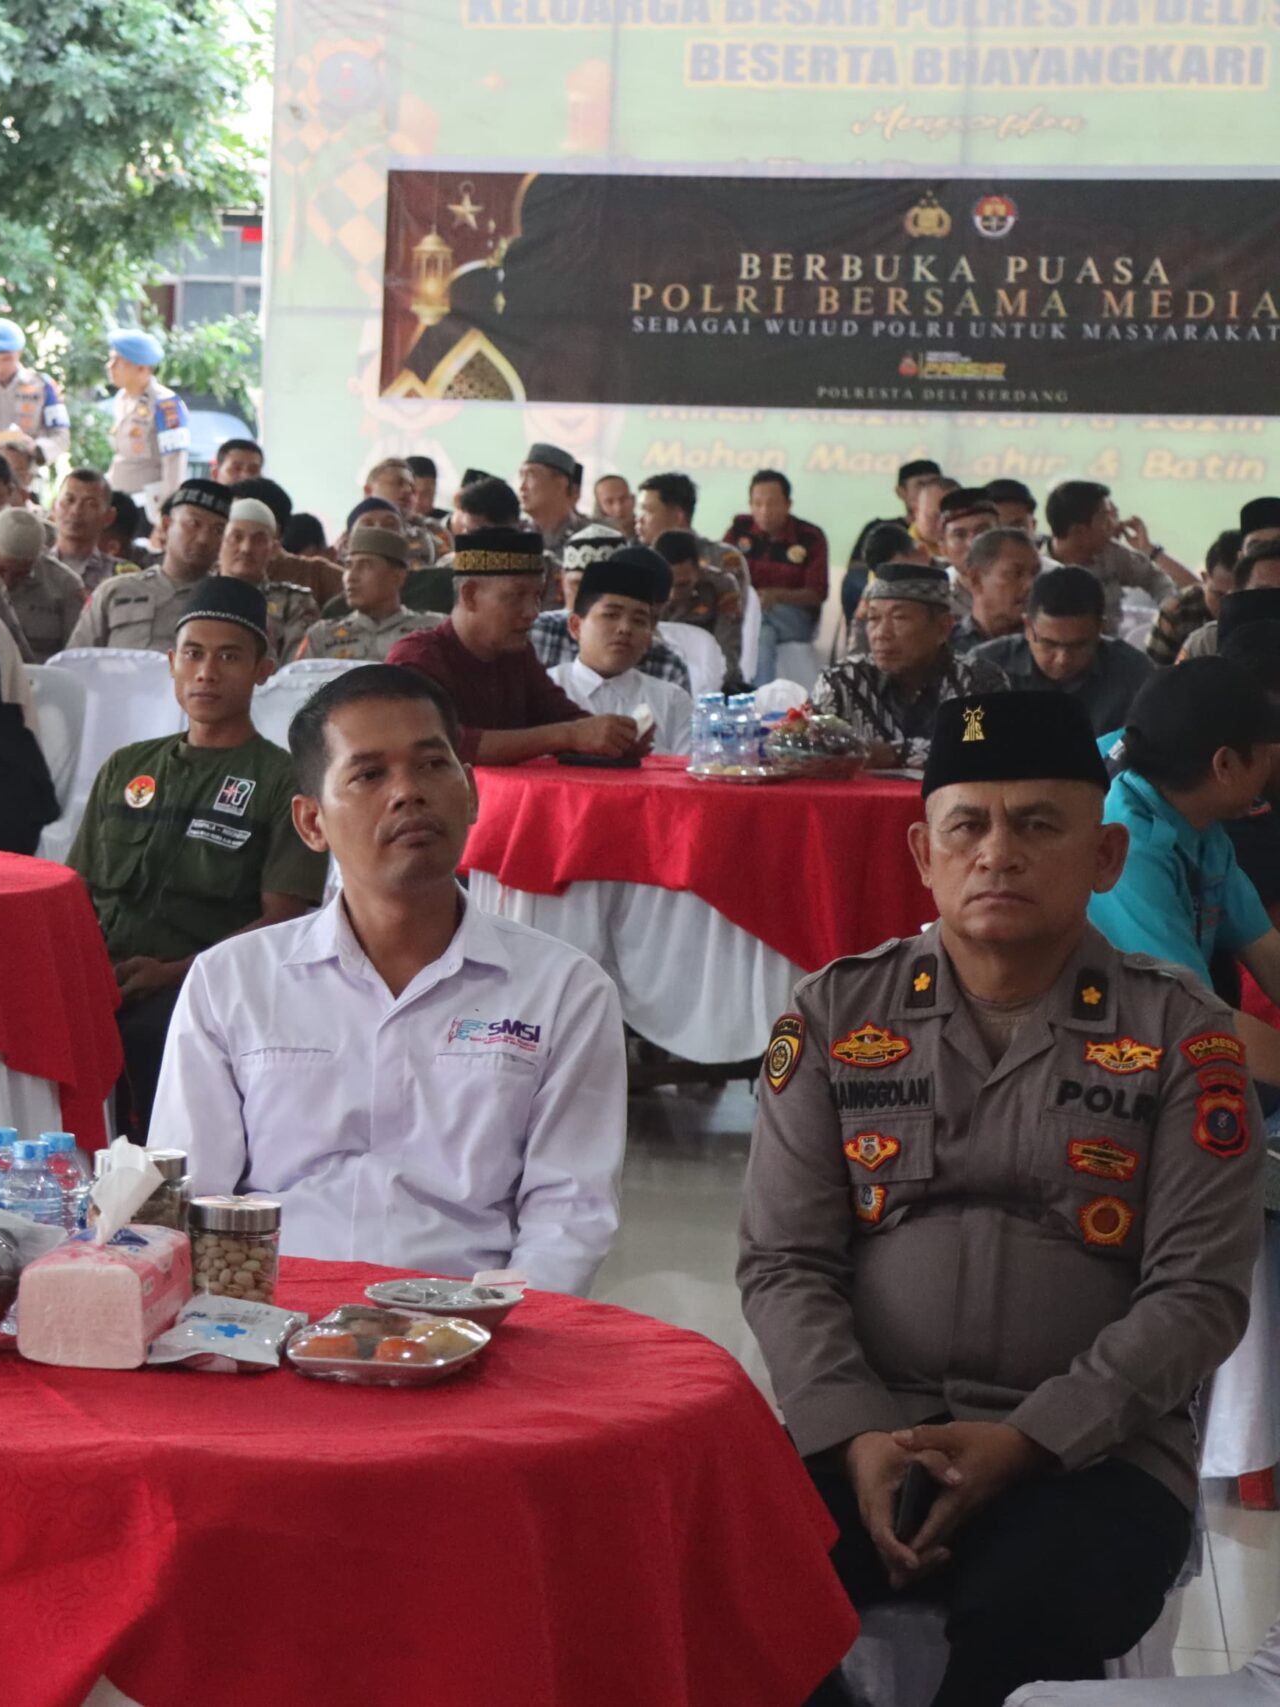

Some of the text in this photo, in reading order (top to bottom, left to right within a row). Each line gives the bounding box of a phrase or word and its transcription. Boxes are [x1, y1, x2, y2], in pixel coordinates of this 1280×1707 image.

[466, 0, 712, 25] KELUARGA
[724, 0, 879, 26] BESAR
[895, 0, 1140, 27] POLRESTA
[1153, 0, 1259, 27] DELI
[688, 42, 1265, 86] BESERTA BHAYANGKARI
[739, 252, 1170, 285] BERBUKA PUASA
[631, 282, 1279, 319] POLRI BERSAMA MEDIA
[632, 316, 751, 335] SEBAGAI
[871, 320, 956, 339] POLRI
[970, 322, 1067, 340] UNTUK
[1082, 323, 1280, 342] MASYARAKAT
[816, 386, 1070, 403] POLRESTA DELI SERDANG
[642, 437, 788, 470] Mohon
[944, 447, 1066, 476] Lahir
[1088, 447, 1120, 478] &
[1143, 448, 1266, 480] Batin
[487, 1019, 541, 1043] SMSI
